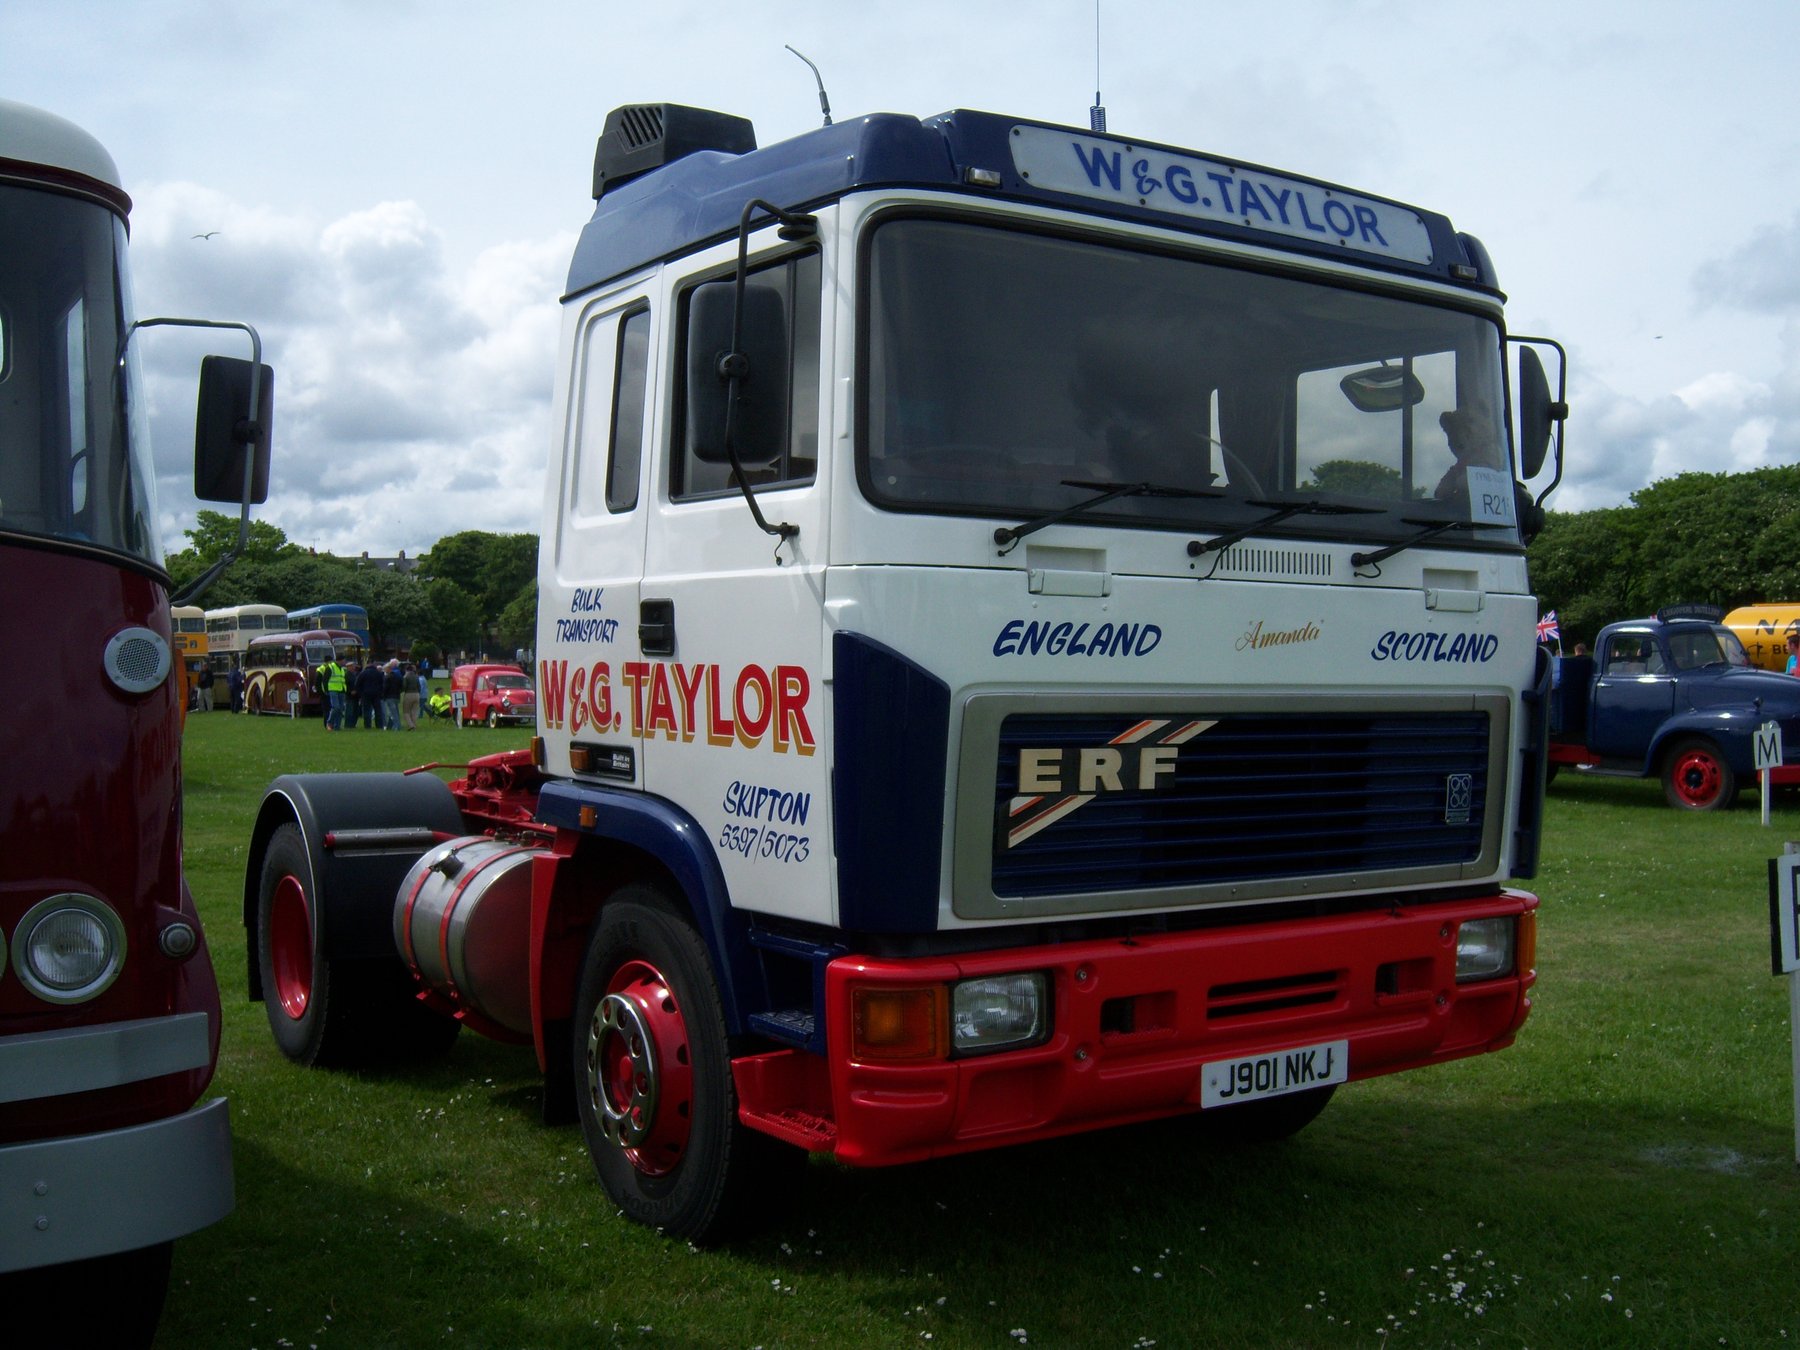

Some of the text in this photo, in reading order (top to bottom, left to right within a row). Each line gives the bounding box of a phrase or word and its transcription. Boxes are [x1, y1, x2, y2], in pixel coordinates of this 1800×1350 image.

[1206, 171, 1389, 247] TAYLOR
[571, 588, 604, 613] BULK
[556, 618, 619, 643] TRANSPORT
[993, 619, 1162, 657] ENGLAND
[1371, 631, 1499, 664] SCOTLAND
[454, 693, 465, 706] H
[622, 661, 817, 757] TAYLOR
[1758, 732, 1779, 766] M
[1019, 747, 1179, 793] ERF
[723, 780, 811, 826] SKIPTON
[1219, 1047, 1332, 1098] J901 NKJ
